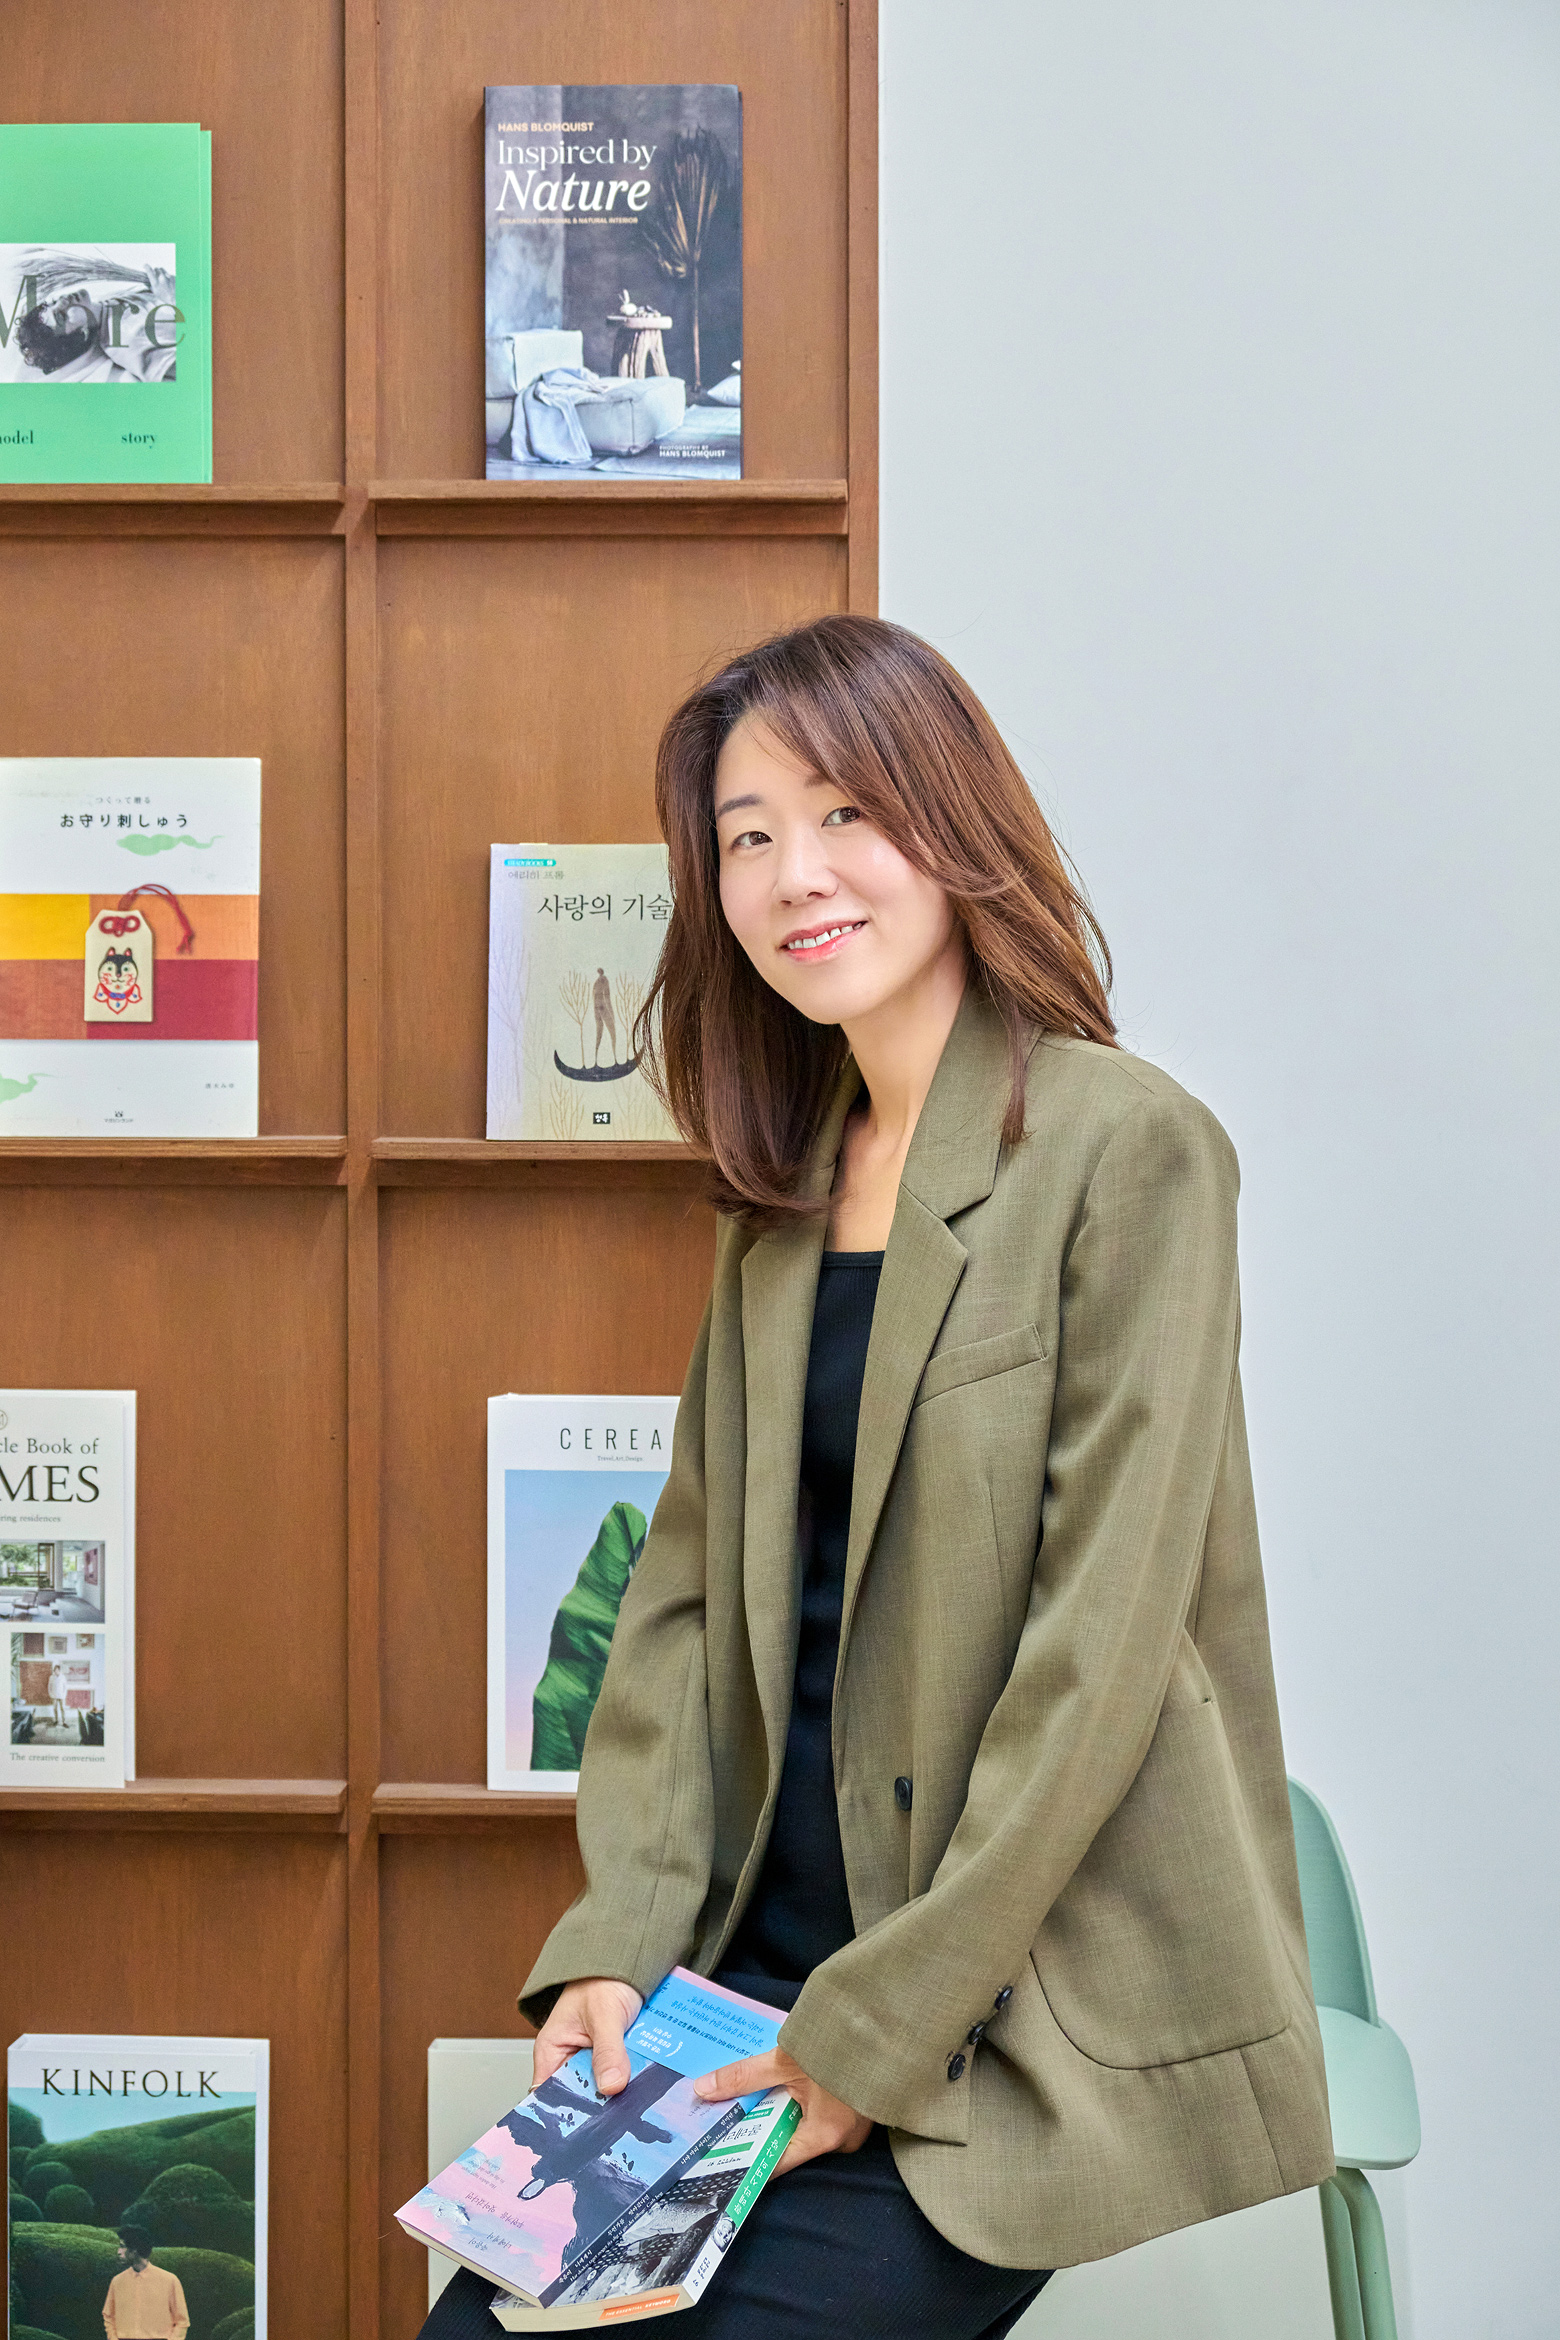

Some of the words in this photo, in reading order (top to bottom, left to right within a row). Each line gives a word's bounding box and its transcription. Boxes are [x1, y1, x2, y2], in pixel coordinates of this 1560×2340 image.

[498, 122, 528, 132] HANS
[530, 122, 594, 132] BLOMQUIST
[497, 139, 615, 171] Inspired
[623, 139, 658, 170] by
[494, 169, 652, 212] Nature
[121, 431, 157, 449] story
[682, 450, 726, 458] BLOMQUIST
[60, 813, 188, 828] お守り刺しゅう
[537, 894, 612, 922] 사랑의
[622, 894, 674, 922] 기술
[27, 1437, 73, 1454] Book
[80, 1437, 100, 1454] of
[20, 1514, 61, 1523] residences
[10, 1752, 26, 1761] The
[28, 1753, 59, 1762] creative
[62, 1754, 105, 1763] conversion
[41, 2068, 223, 2099] KINFOLK
[680, 2154, 691, 2165] 나야
[733, 2185, 752, 2215] 콜레라
[750, 2157, 769, 2186] 시대의
[766, 2138, 780, 2158] 사랑
[465, 2191, 497, 2213] 앗아갔다면
[500, 2211, 525, 2229] 무언가를
[468, 2237, 488, 2251] 죽음이
[486, 2231, 512, 2249] 너에게서
[558, 2269, 573, 2283] 죽음이
[645, 2299, 671, 2308] KEYWORD
